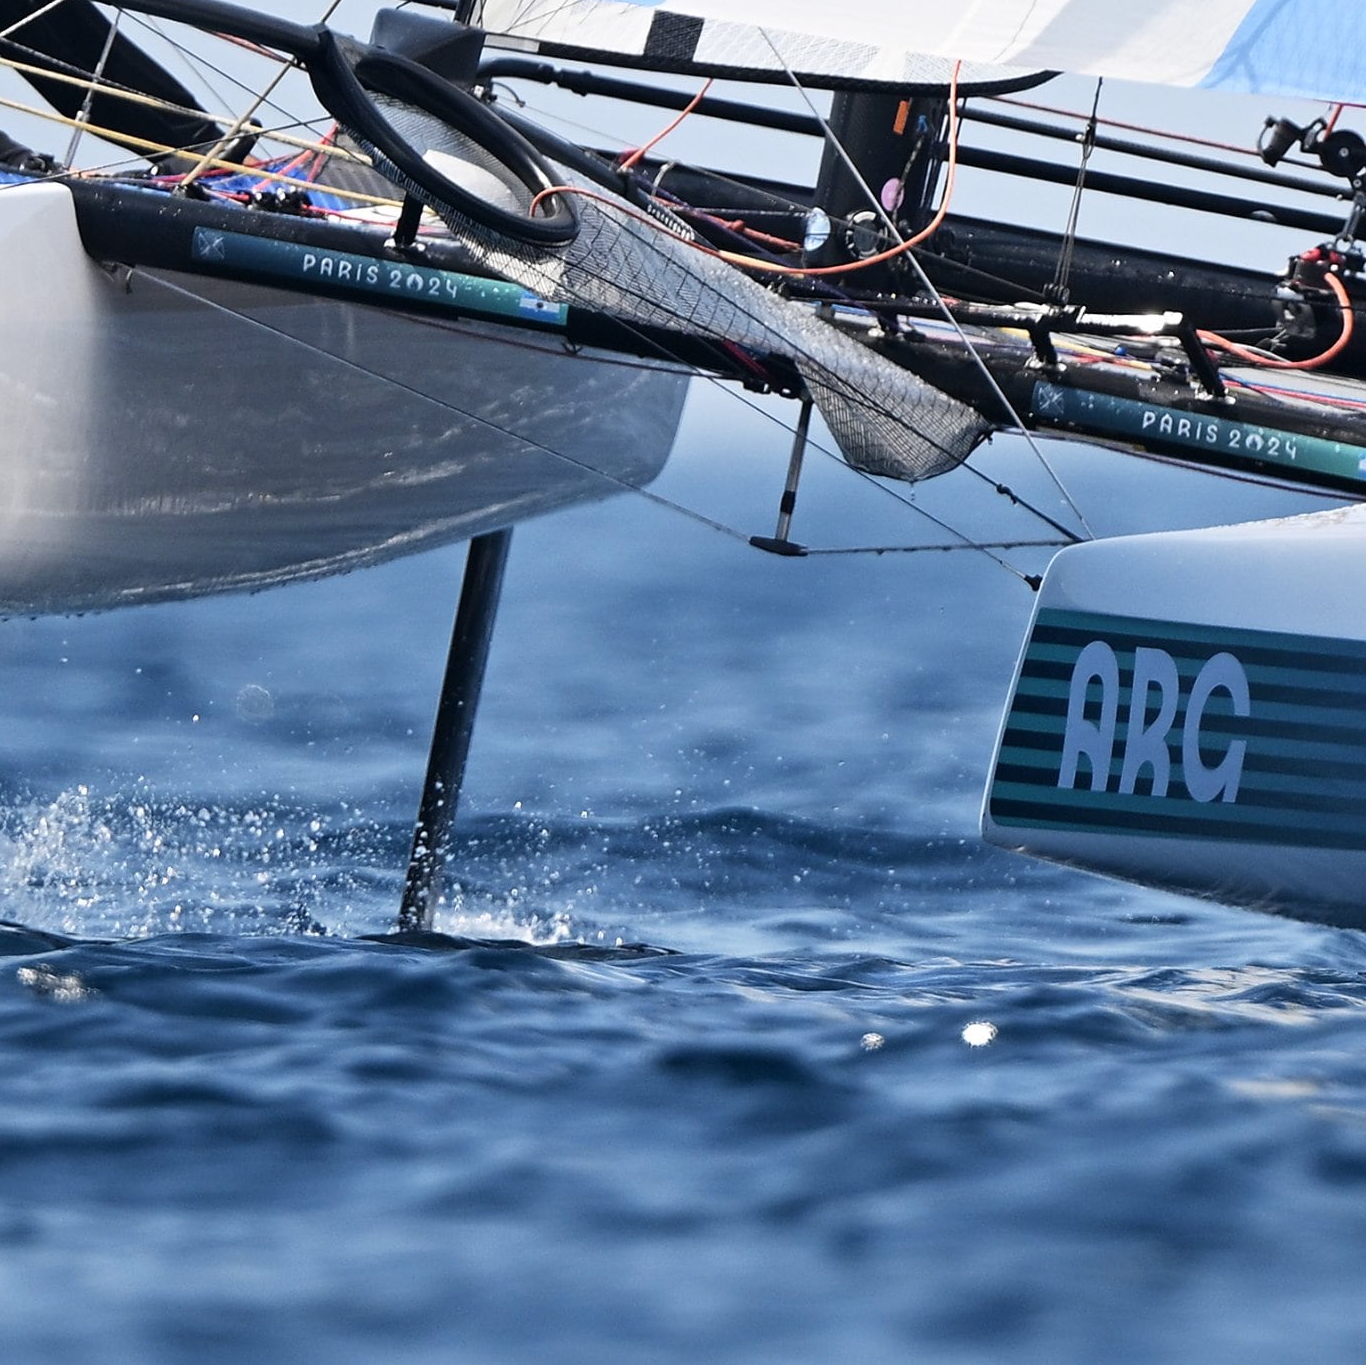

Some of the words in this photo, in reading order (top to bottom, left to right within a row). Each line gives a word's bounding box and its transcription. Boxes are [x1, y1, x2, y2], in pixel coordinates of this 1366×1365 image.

[389, 269, 458, 299] 2024
[1229, 429, 1297, 460] 2024
[1057, 640, 1251, 803] ARG
